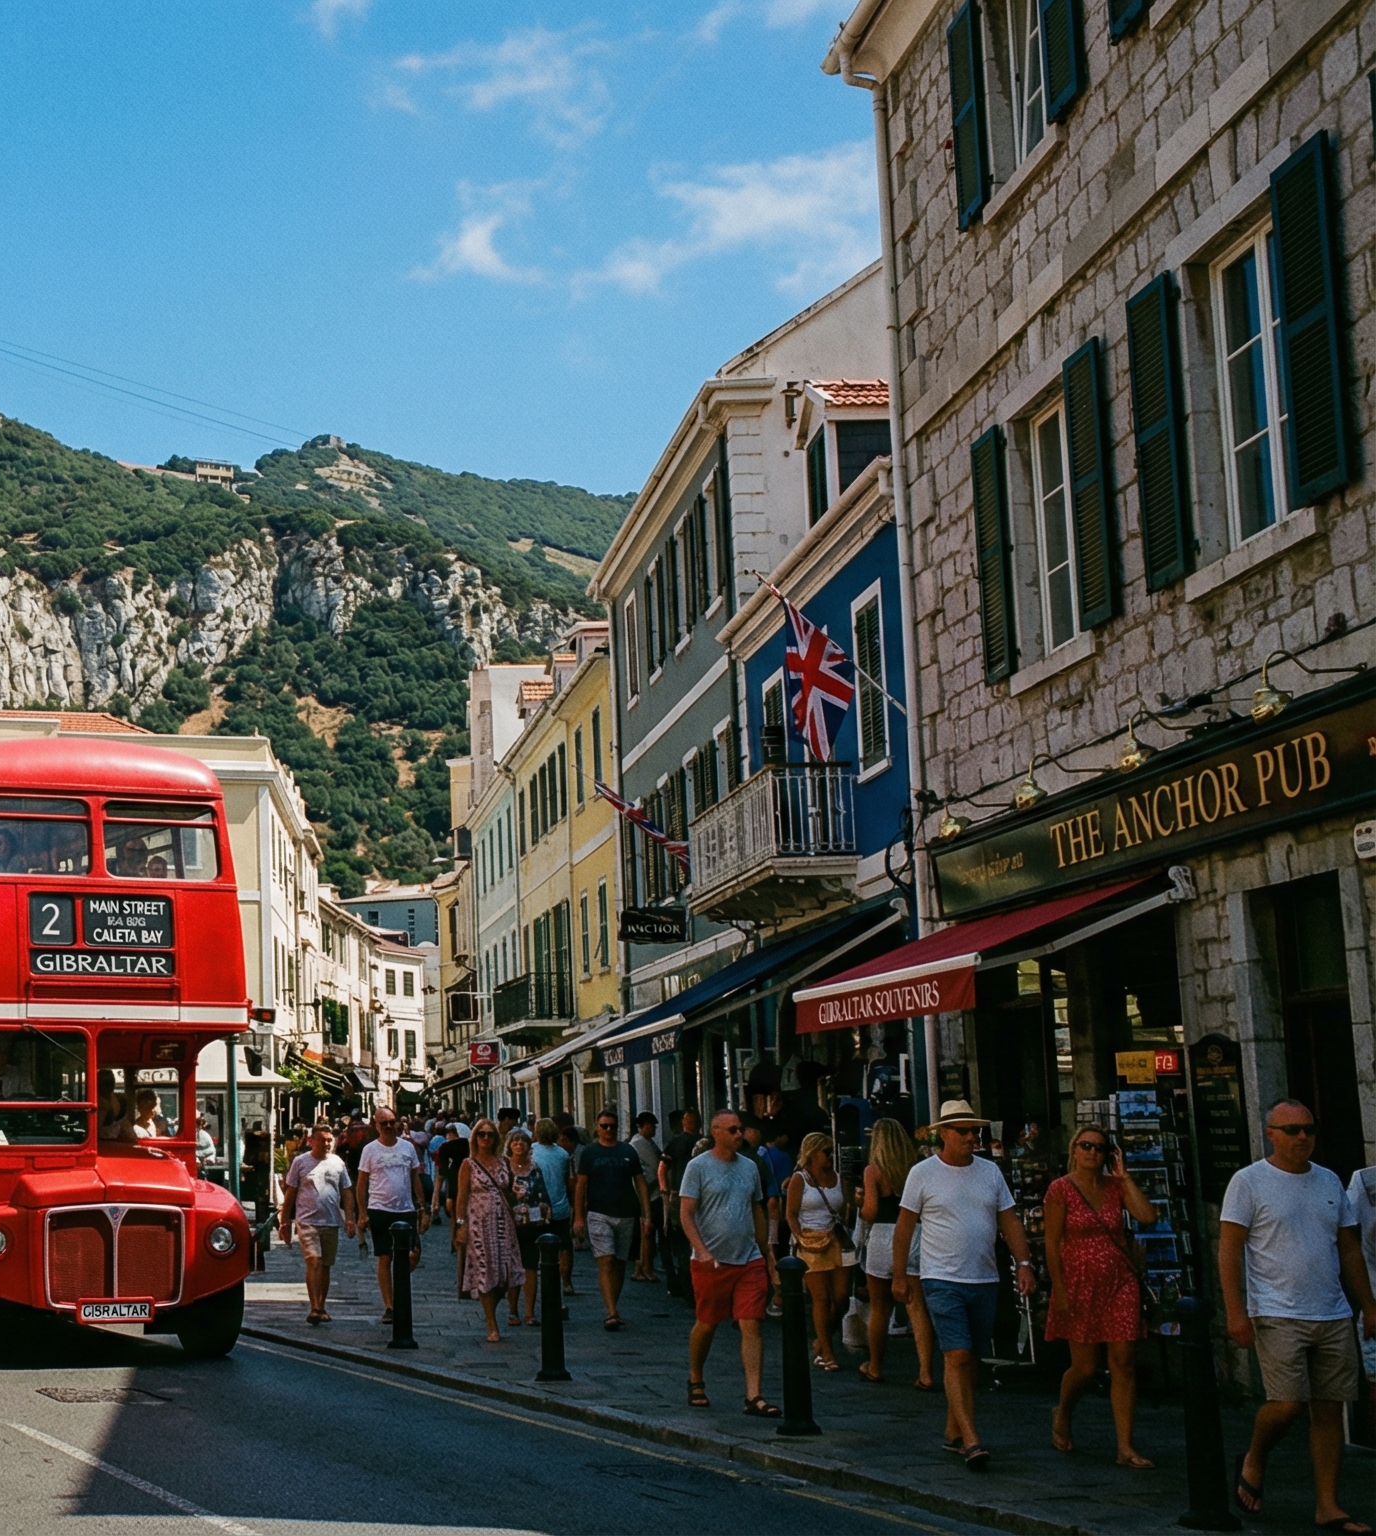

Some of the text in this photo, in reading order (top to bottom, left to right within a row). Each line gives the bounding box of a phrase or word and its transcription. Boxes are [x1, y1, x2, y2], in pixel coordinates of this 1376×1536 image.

[1049, 809, 1105, 869] THE
[1113, 762, 1249, 851] ANCHOR
[1252, 731, 1331, 808] PUB
[41, 903, 61, 935] 2
[89, 900, 166, 915] MAIN STREET
[93, 928, 163, 944] CALETA BAY
[36, 953, 168, 974] GIBRALTAR
[818, 980, 940, 1024] GIBRALTAR SOUVENIRS
